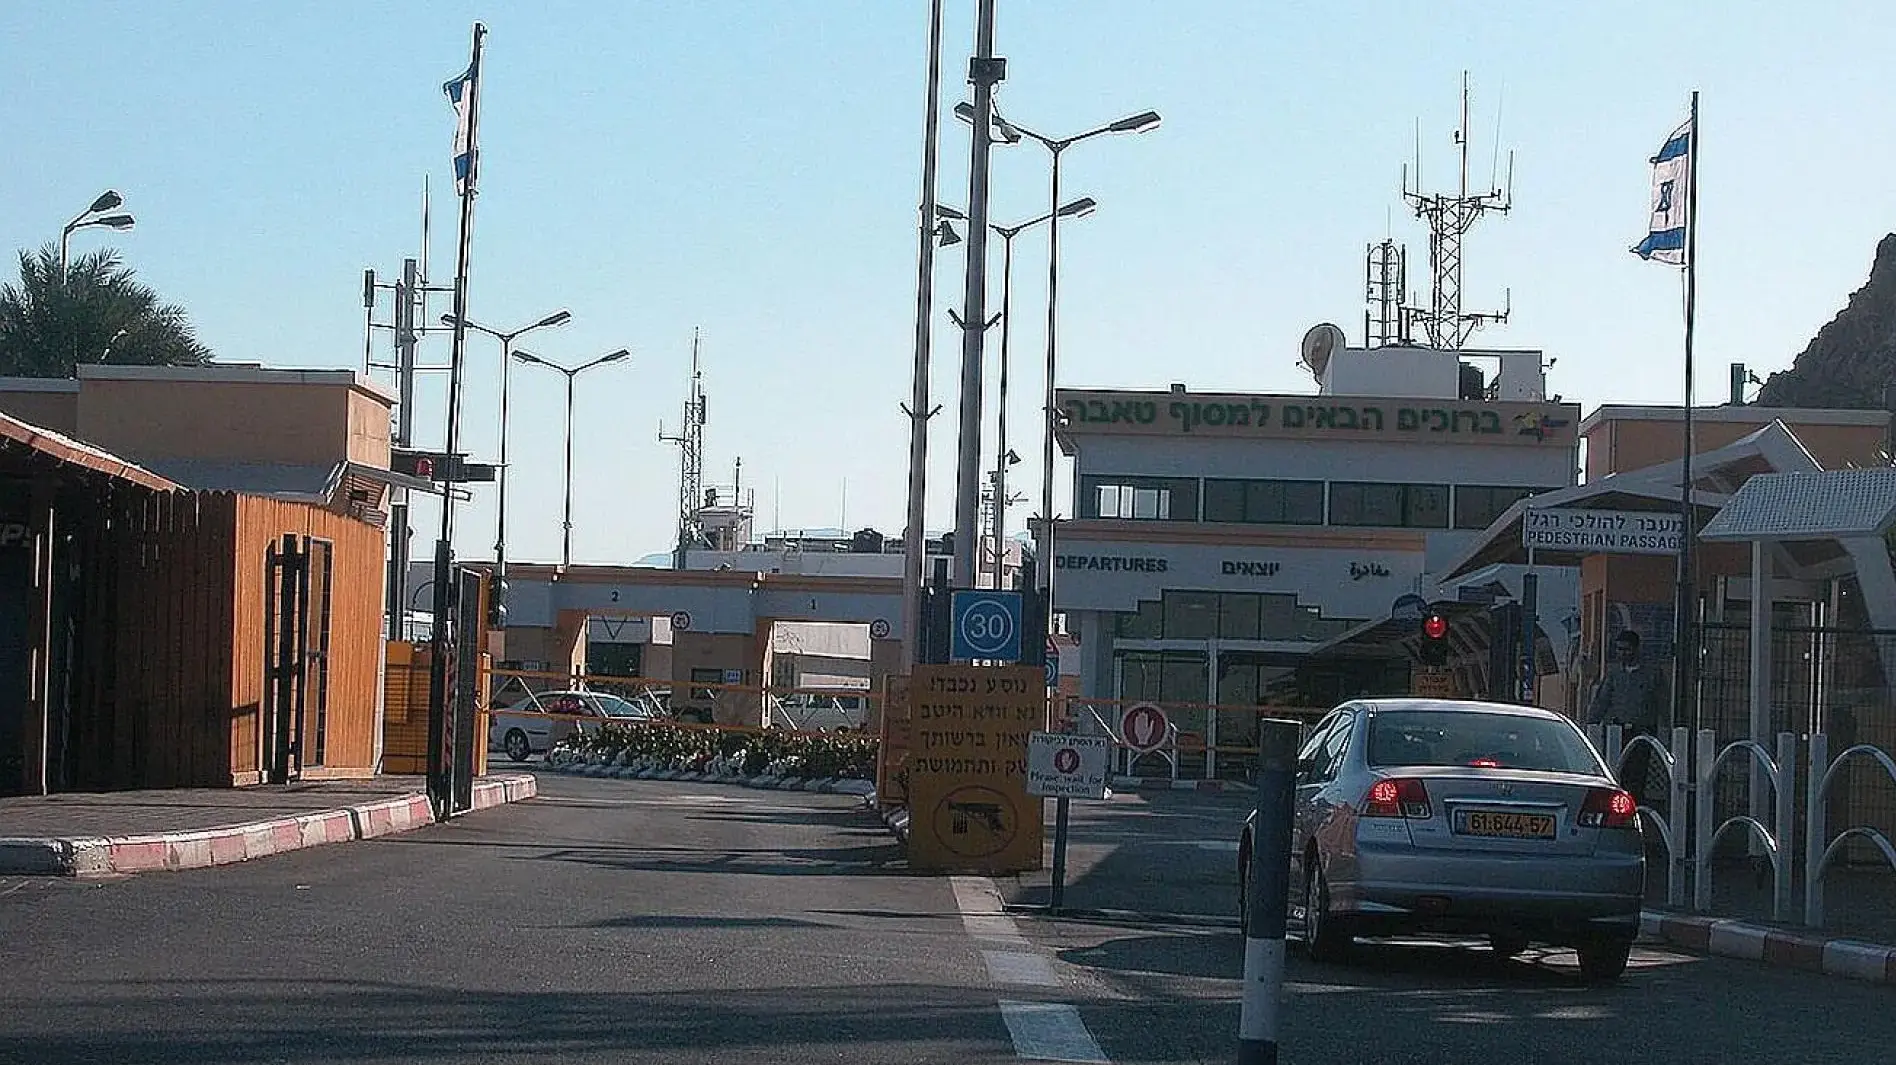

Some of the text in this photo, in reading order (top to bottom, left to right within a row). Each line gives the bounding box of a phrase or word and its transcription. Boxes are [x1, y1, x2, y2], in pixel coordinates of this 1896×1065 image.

[1169, 399, 1271, 432] למסוף
[1283, 404, 1384, 431] הבאים
[1397, 408, 1500, 434] ברוכים
[1529, 511, 1684, 533] מעבר להולכי רגל
[1528, 531, 1616, 547] PEDESTRIAN
[1056, 555, 1168, 573] DEPARTURES
[1221, 560, 1281, 577] יוצאים
[611, 591, 620, 603] 2
[809, 598, 816, 610] 1
[970, 613, 1004, 639] 30
[987, 676, 1027, 694] נוסע
[1016, 704, 1035, 720] נא
[1005, 758, 1028, 778] שק
